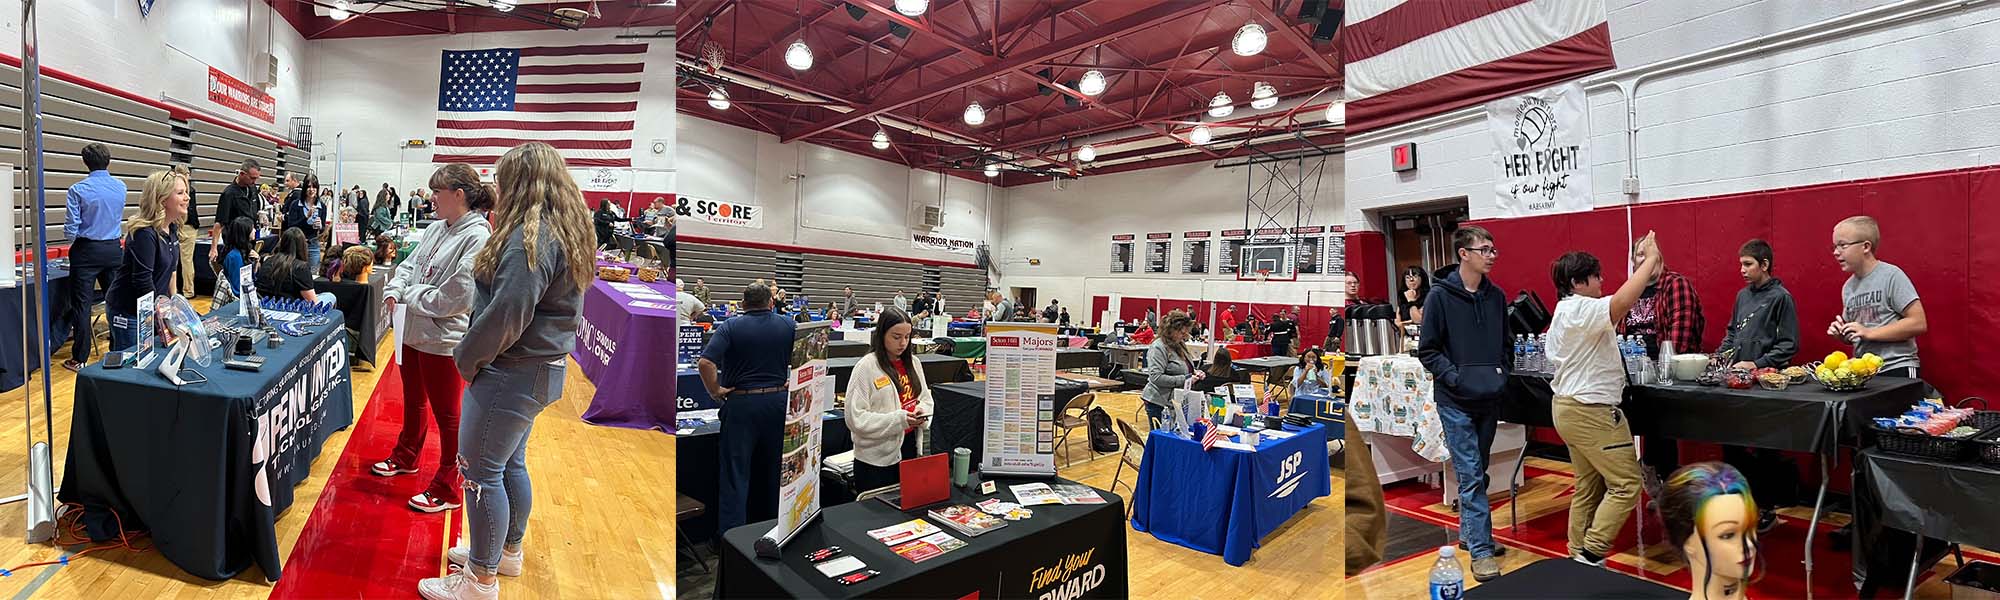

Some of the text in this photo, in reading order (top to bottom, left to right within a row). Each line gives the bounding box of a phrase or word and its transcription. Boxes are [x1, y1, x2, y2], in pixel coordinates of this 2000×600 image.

[1503, 153, 1531, 177] HER
[1542, 174, 1570, 200] fight
[697, 200, 752, 220] SCORE
[913, 234, 975, 248] WARRIOR NATION
[1023, 337, 1054, 347] Majors
[1277, 451, 1303, 484] JSP
[1029, 548, 1094, 593] Find Your
